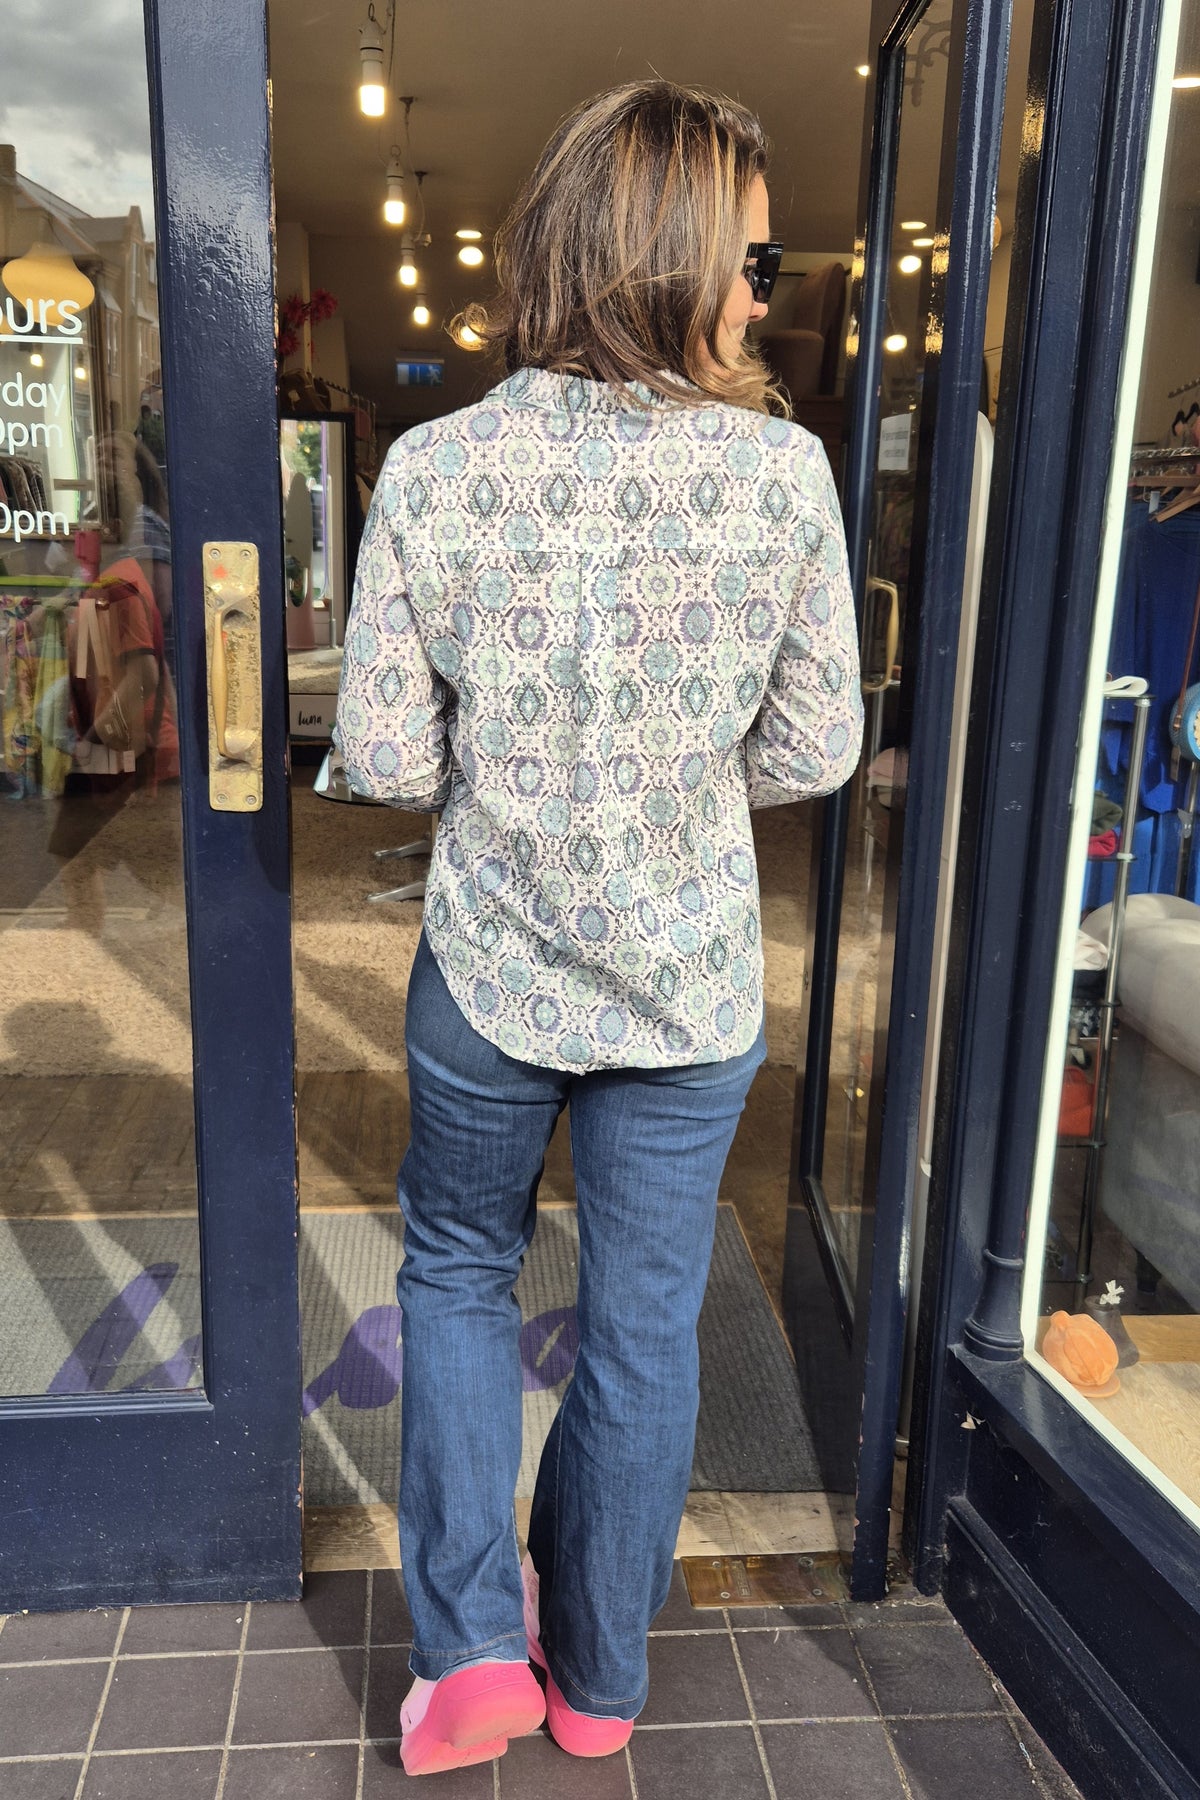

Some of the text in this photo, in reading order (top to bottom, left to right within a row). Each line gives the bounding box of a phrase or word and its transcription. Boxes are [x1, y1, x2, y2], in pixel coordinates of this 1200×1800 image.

[0, 297, 82, 335] urs
[0, 372, 66, 416] day
[0, 417, 63, 455] pm
